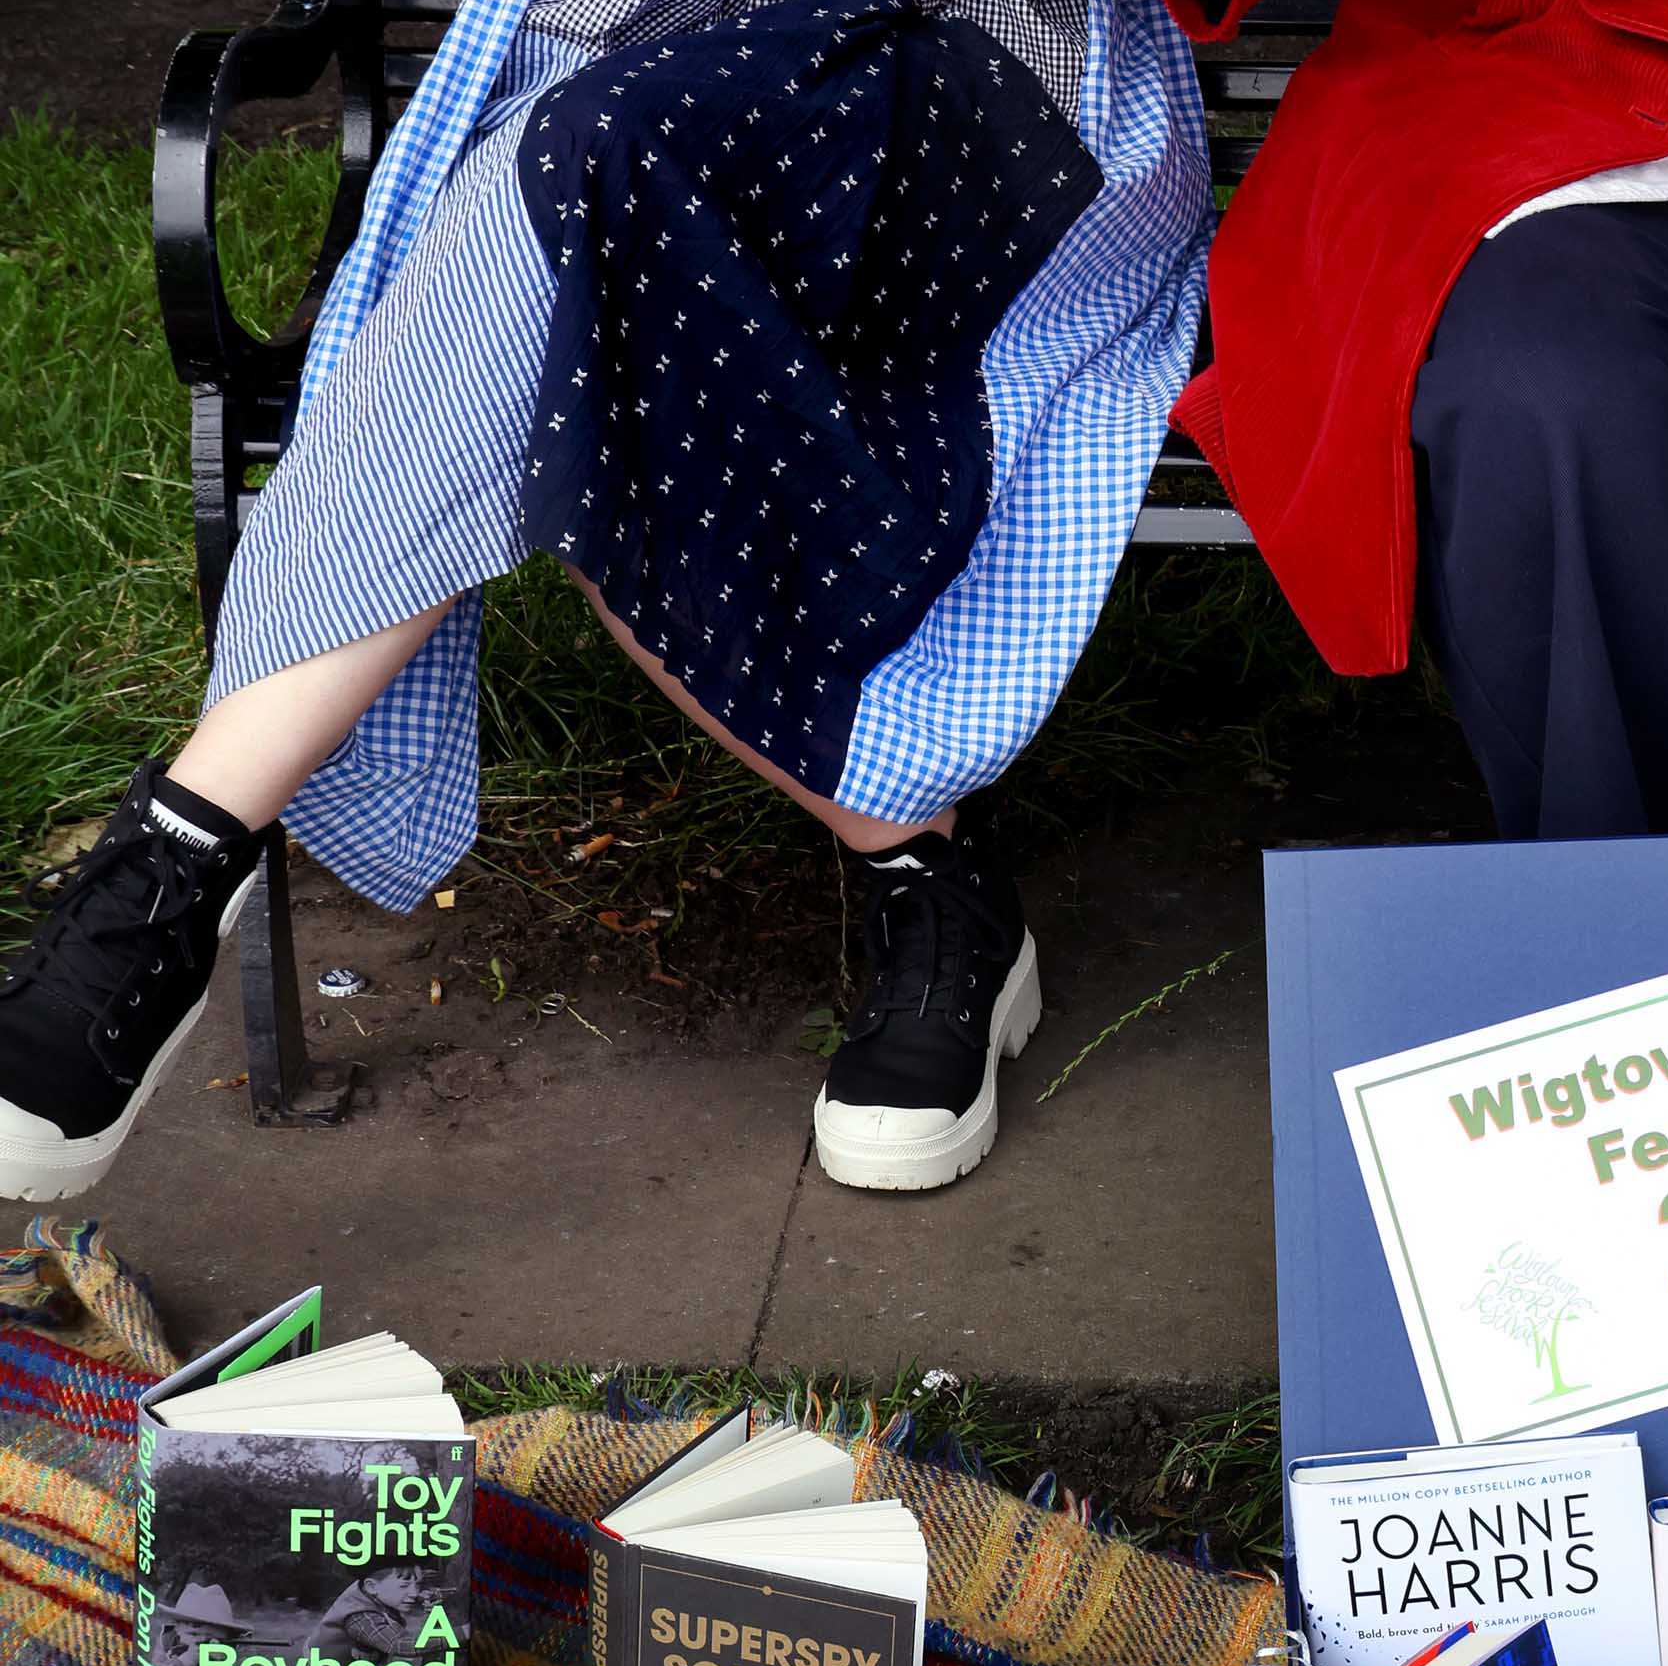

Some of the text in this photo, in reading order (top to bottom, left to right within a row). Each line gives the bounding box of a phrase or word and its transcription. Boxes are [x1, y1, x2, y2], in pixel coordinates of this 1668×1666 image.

[364, 1465, 464, 1521] Toy
[1330, 1470, 1592, 1506] THE MILLION COPY BESTSELLING AUTHOR
[289, 1508, 461, 1567] Fights
[1341, 1494, 1593, 1563] JOANNE
[1347, 1544, 1598, 1617] HARRIS
[414, 1605, 460, 1648] A
